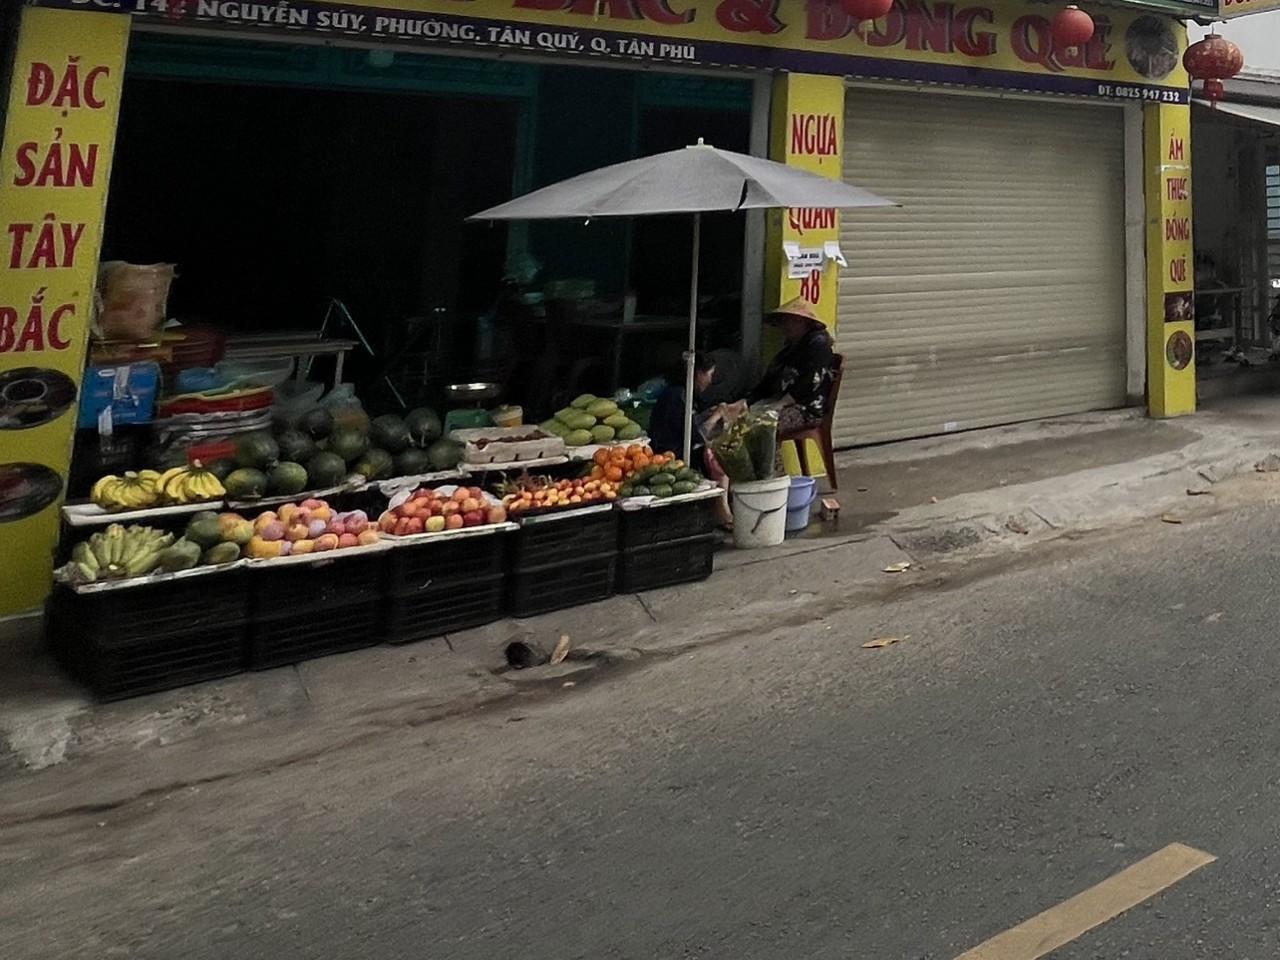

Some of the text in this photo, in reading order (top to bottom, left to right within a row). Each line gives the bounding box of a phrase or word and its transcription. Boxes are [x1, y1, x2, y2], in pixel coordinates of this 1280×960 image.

[196, 0, 308, 25] NGUYỄN
[488, 25, 530, 45] TÂN
[617, 37, 655, 56] TÂN
[659, 43, 696, 60] PHÚ
[25, 55, 110, 118] ĐẶC
[1115, 86, 1140, 98] 0825
[1142, 88, 1160, 100] 947
[1162, 91, 1180, 102] 232
[13, 127, 99, 187] SẢN
[791, 113, 838, 164] NGỰA
[8, 212, 86, 269] TÂY
[0, 286, 76, 353] BẮC
